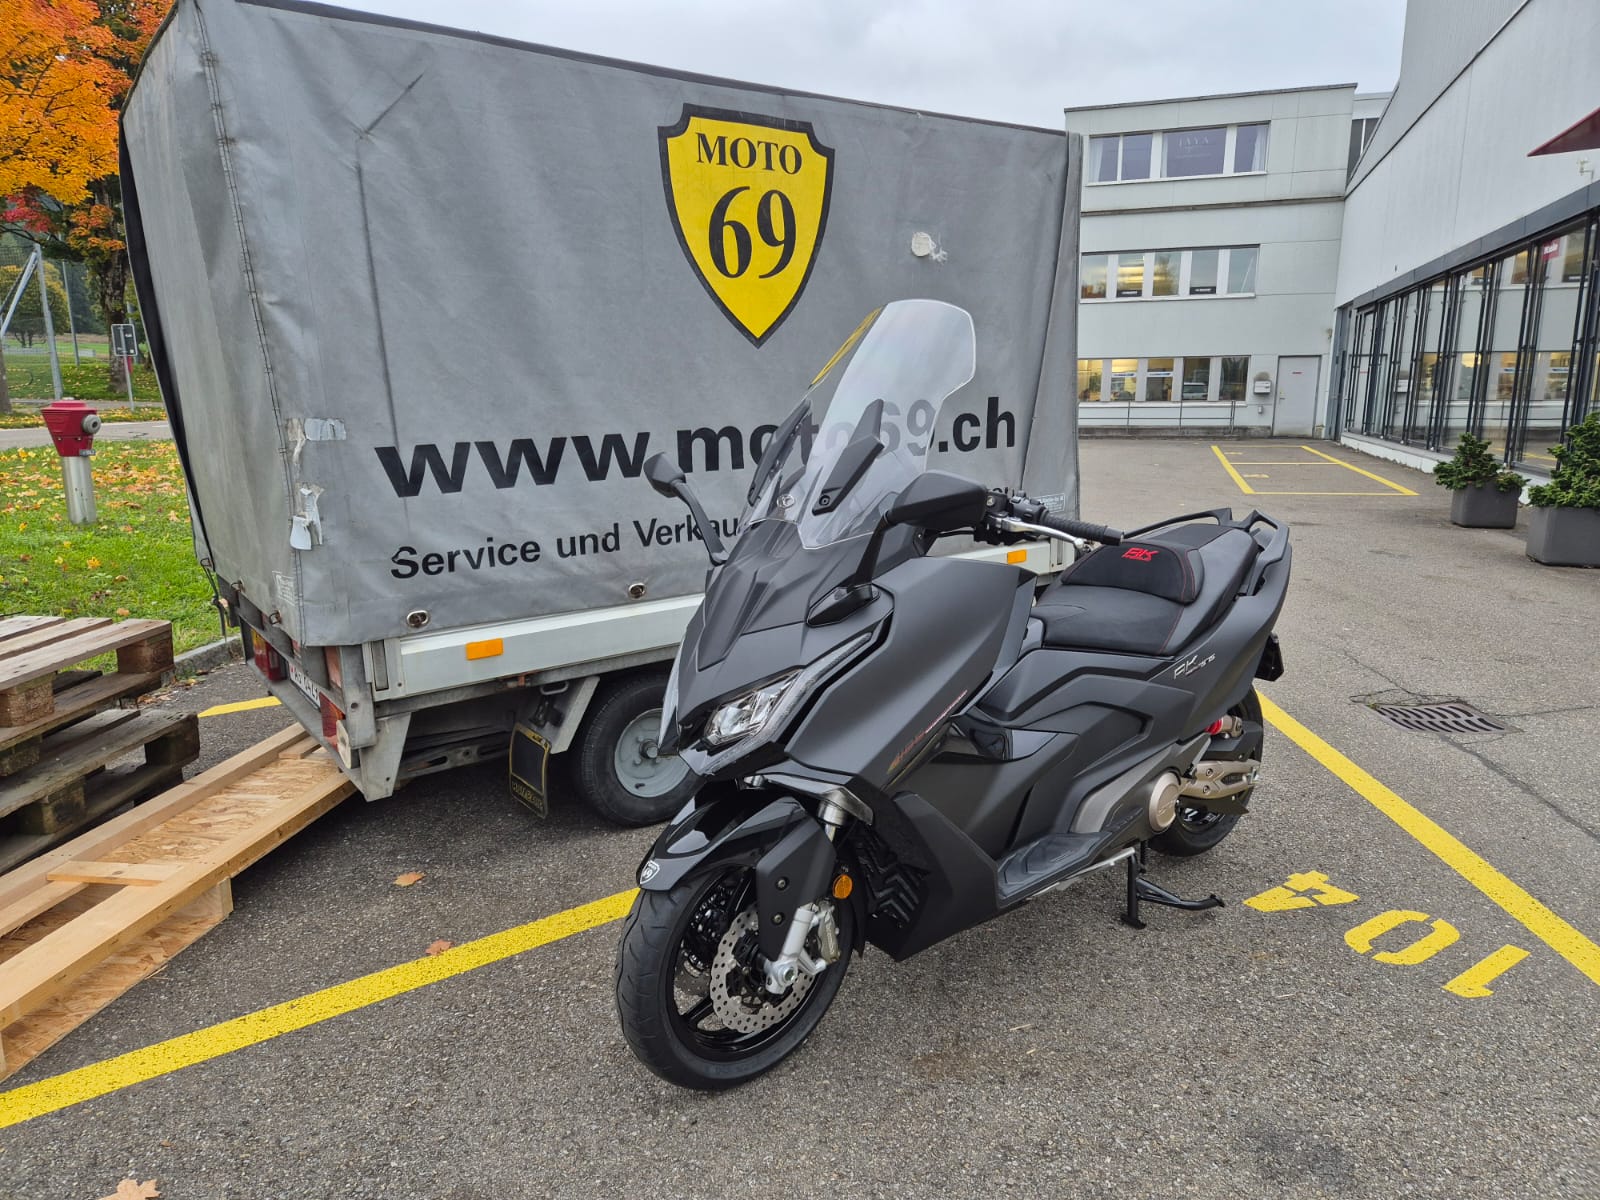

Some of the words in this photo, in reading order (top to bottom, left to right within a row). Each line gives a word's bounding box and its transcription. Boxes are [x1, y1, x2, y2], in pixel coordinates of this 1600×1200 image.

[695, 131, 803, 175] MOTO
[708, 185, 797, 280] 69
[390, 537, 541, 579] Service
[556, 522, 621, 559] und
